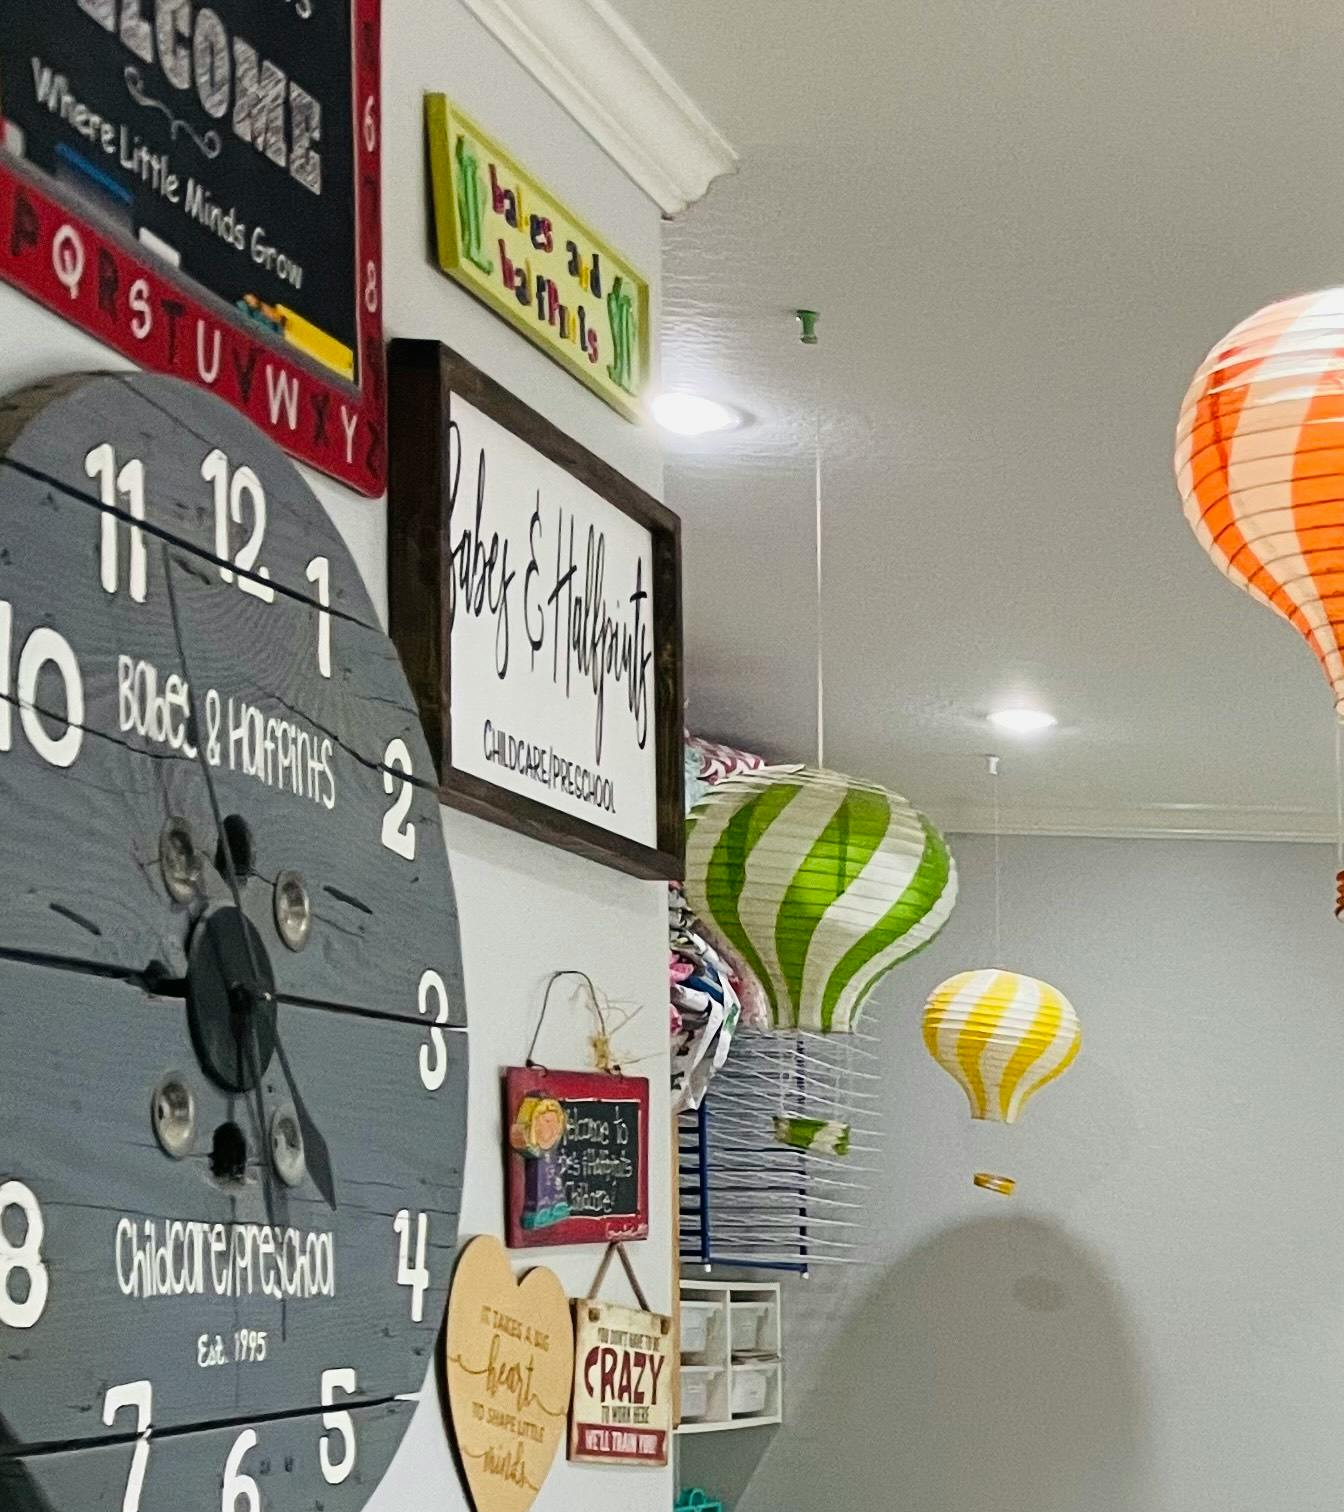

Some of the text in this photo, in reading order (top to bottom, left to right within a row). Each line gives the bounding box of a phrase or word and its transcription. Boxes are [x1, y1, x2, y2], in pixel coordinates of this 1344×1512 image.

[78, 0, 321, 195] LCOME
[364, 96, 376, 152] 6
[31, 56, 304, 290] Where Little Minds Grow
[53, 224, 84, 299] Q
[129, 278, 152, 339] S
[197, 319, 221, 383] U
[266, 364, 299, 430] W
[341, 405, 357, 463] Y
[365, 260, 378, 313] 8
[84, 443, 147, 603] 11
[201, 449, 275, 604] 12
[524, 488, 544, 673] &
[306, 555, 332, 678] 1
[206, 689, 221, 766] &
[381, 738, 416, 861] 2
[419, 969, 449, 1090] 3
[563, 1107, 610, 1146] elcome
[0, 1181, 49, 1328] 8
[393, 1208, 429, 1323] 4
[235, 1328, 267, 1362] 1995
[584, 1345, 665, 1406] CRAZY
[319, 1368, 356, 1484] 5
